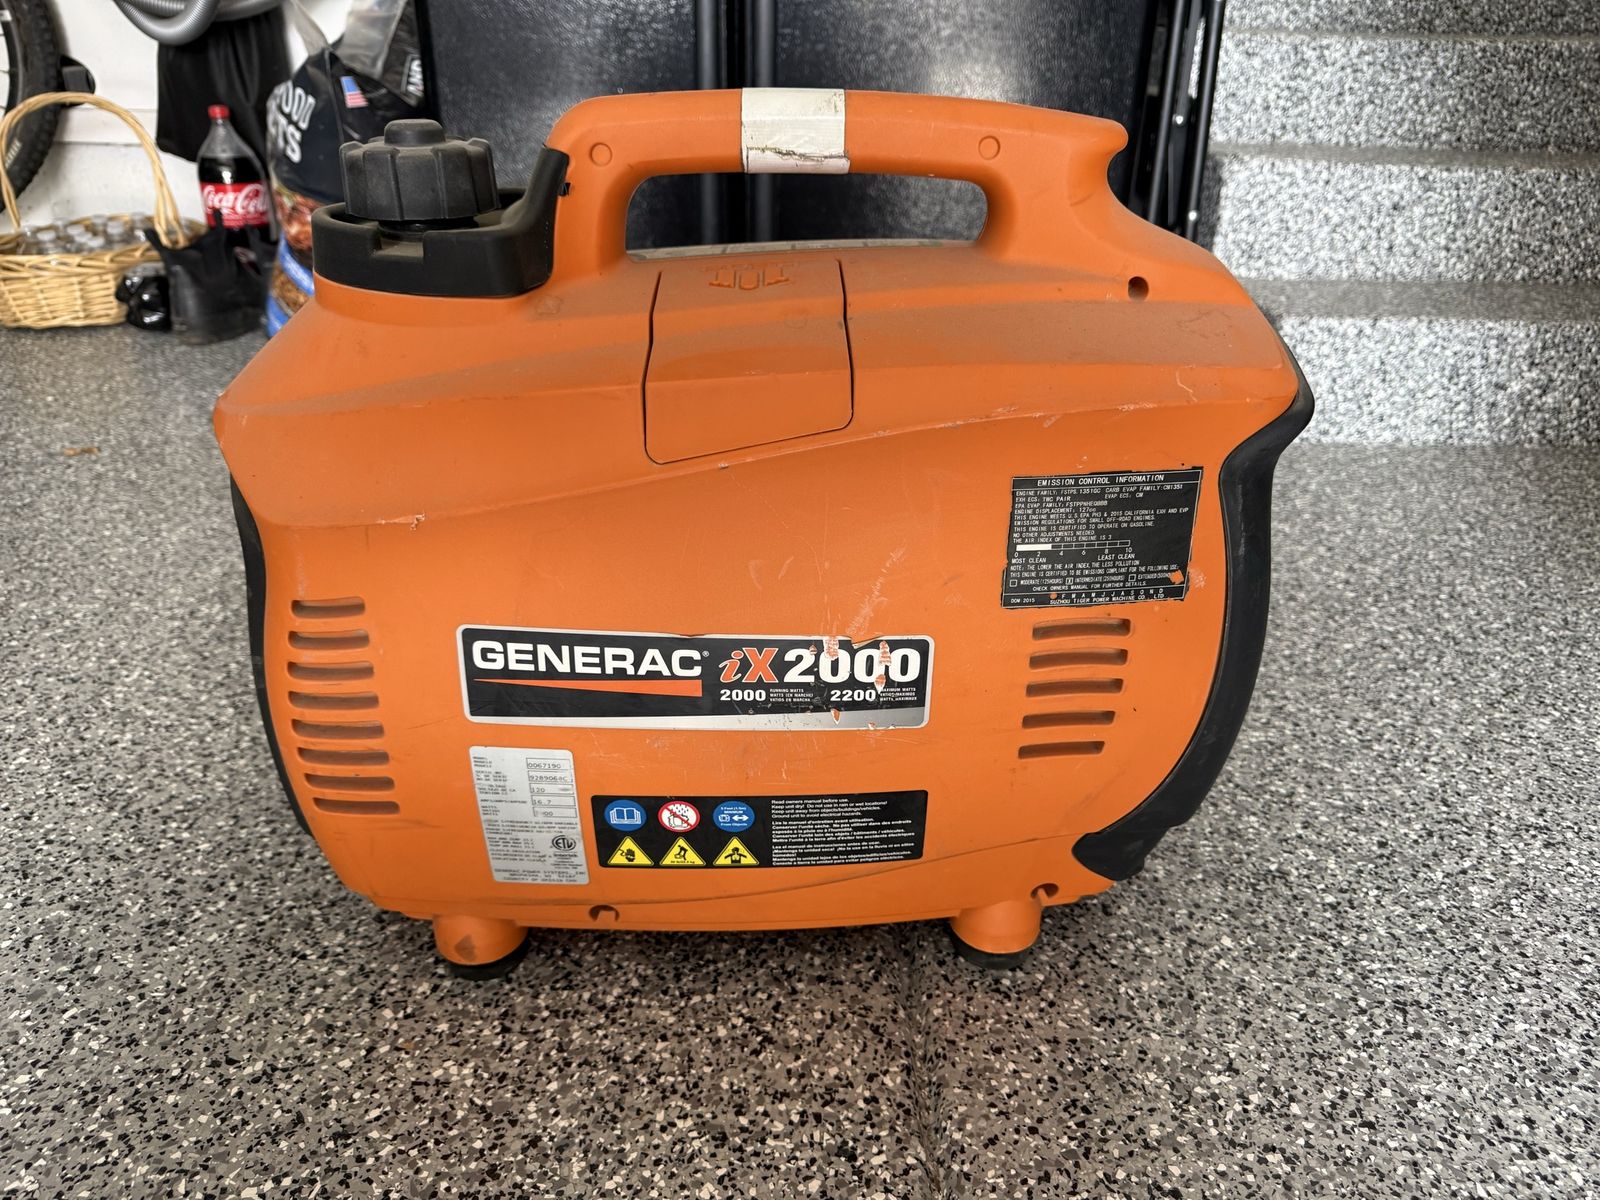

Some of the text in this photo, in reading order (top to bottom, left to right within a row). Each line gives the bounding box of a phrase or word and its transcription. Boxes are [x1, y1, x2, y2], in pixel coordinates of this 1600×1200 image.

[1037, 478, 1074, 486] EMISSION
[1115, 474, 1164, 482] INFORMATION
[720, 689, 876, 702] 2000 2200
